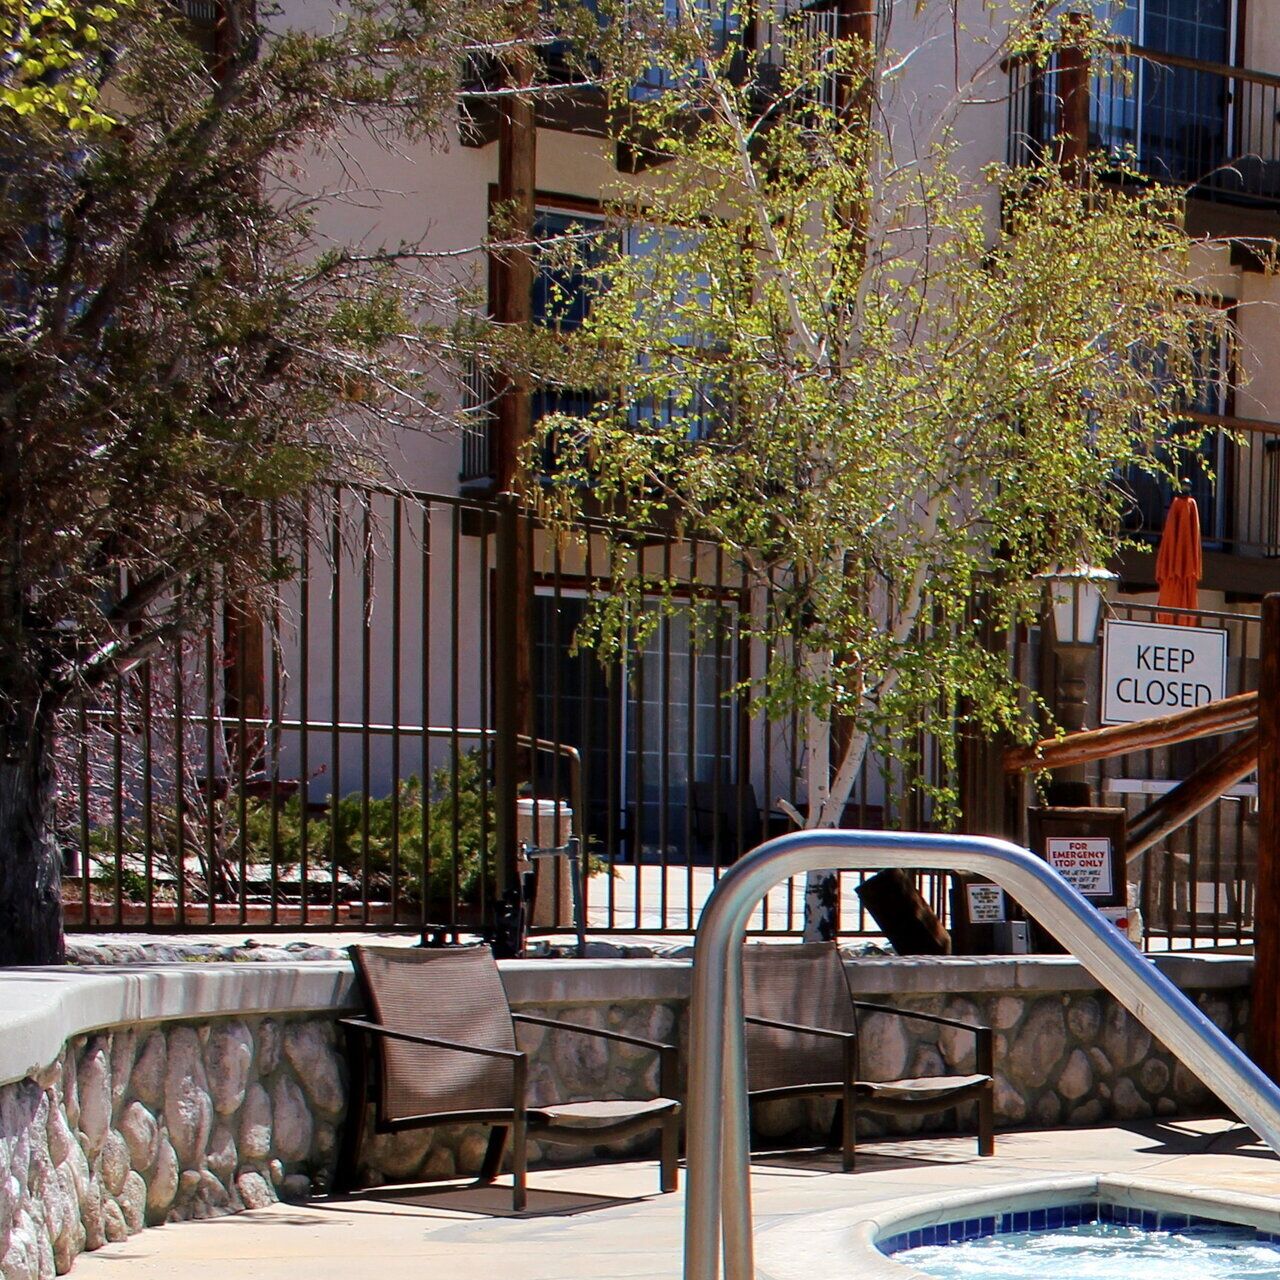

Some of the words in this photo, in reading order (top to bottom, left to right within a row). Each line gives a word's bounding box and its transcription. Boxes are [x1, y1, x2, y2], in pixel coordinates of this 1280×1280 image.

[1136, 644, 1195, 674] KEEP
[1116, 677, 1213, 708] CLOSED
[1052, 851, 1105, 859] EMERGENCY
[1069, 842, 1088, 850] FOR
